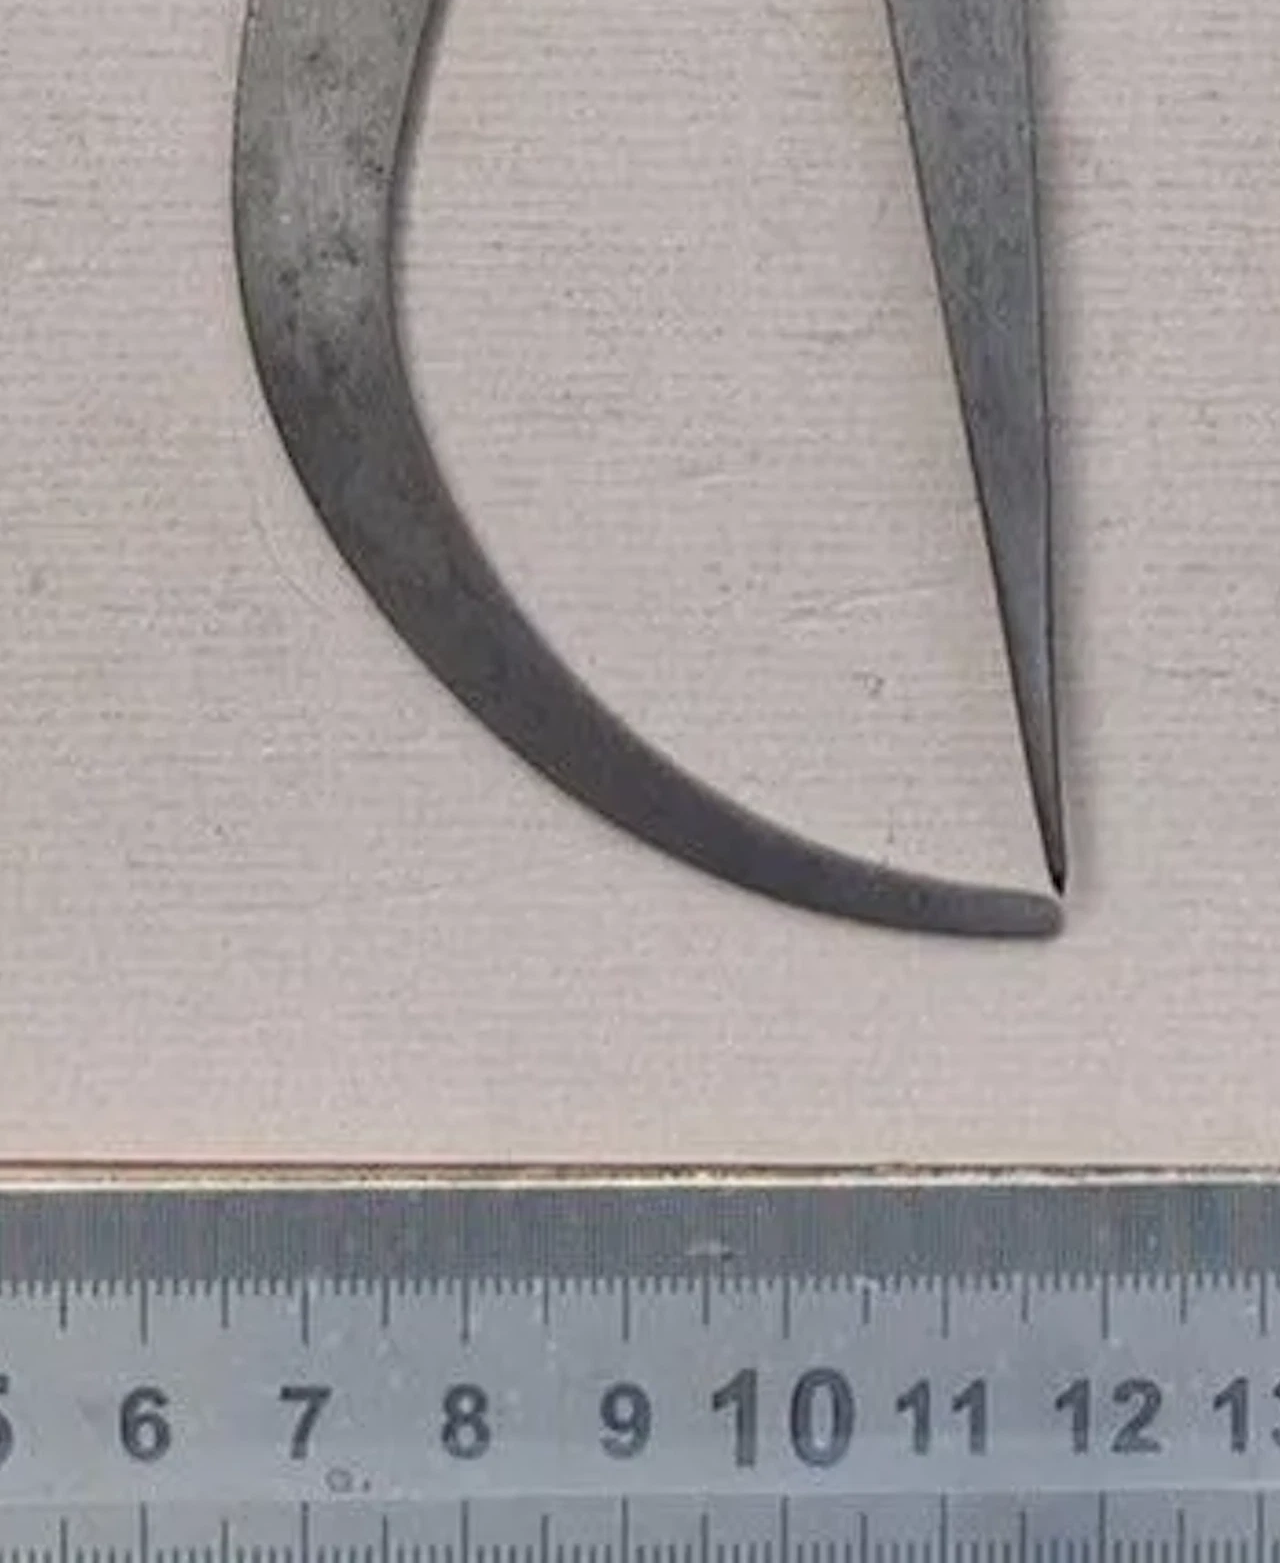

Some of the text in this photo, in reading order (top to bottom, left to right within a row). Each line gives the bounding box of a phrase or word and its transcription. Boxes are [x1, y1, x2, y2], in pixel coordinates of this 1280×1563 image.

[119, 1386, 171, 1462] 6
[280, 1387, 331, 1460] 7
[441, 1384, 491, 1460] 8
[600, 1383, 651, 1459] 9
[712, 1368, 855, 1468] 10
[895, 1379, 988, 1456] 11
[1054, 1379, 1162, 1454] 12
